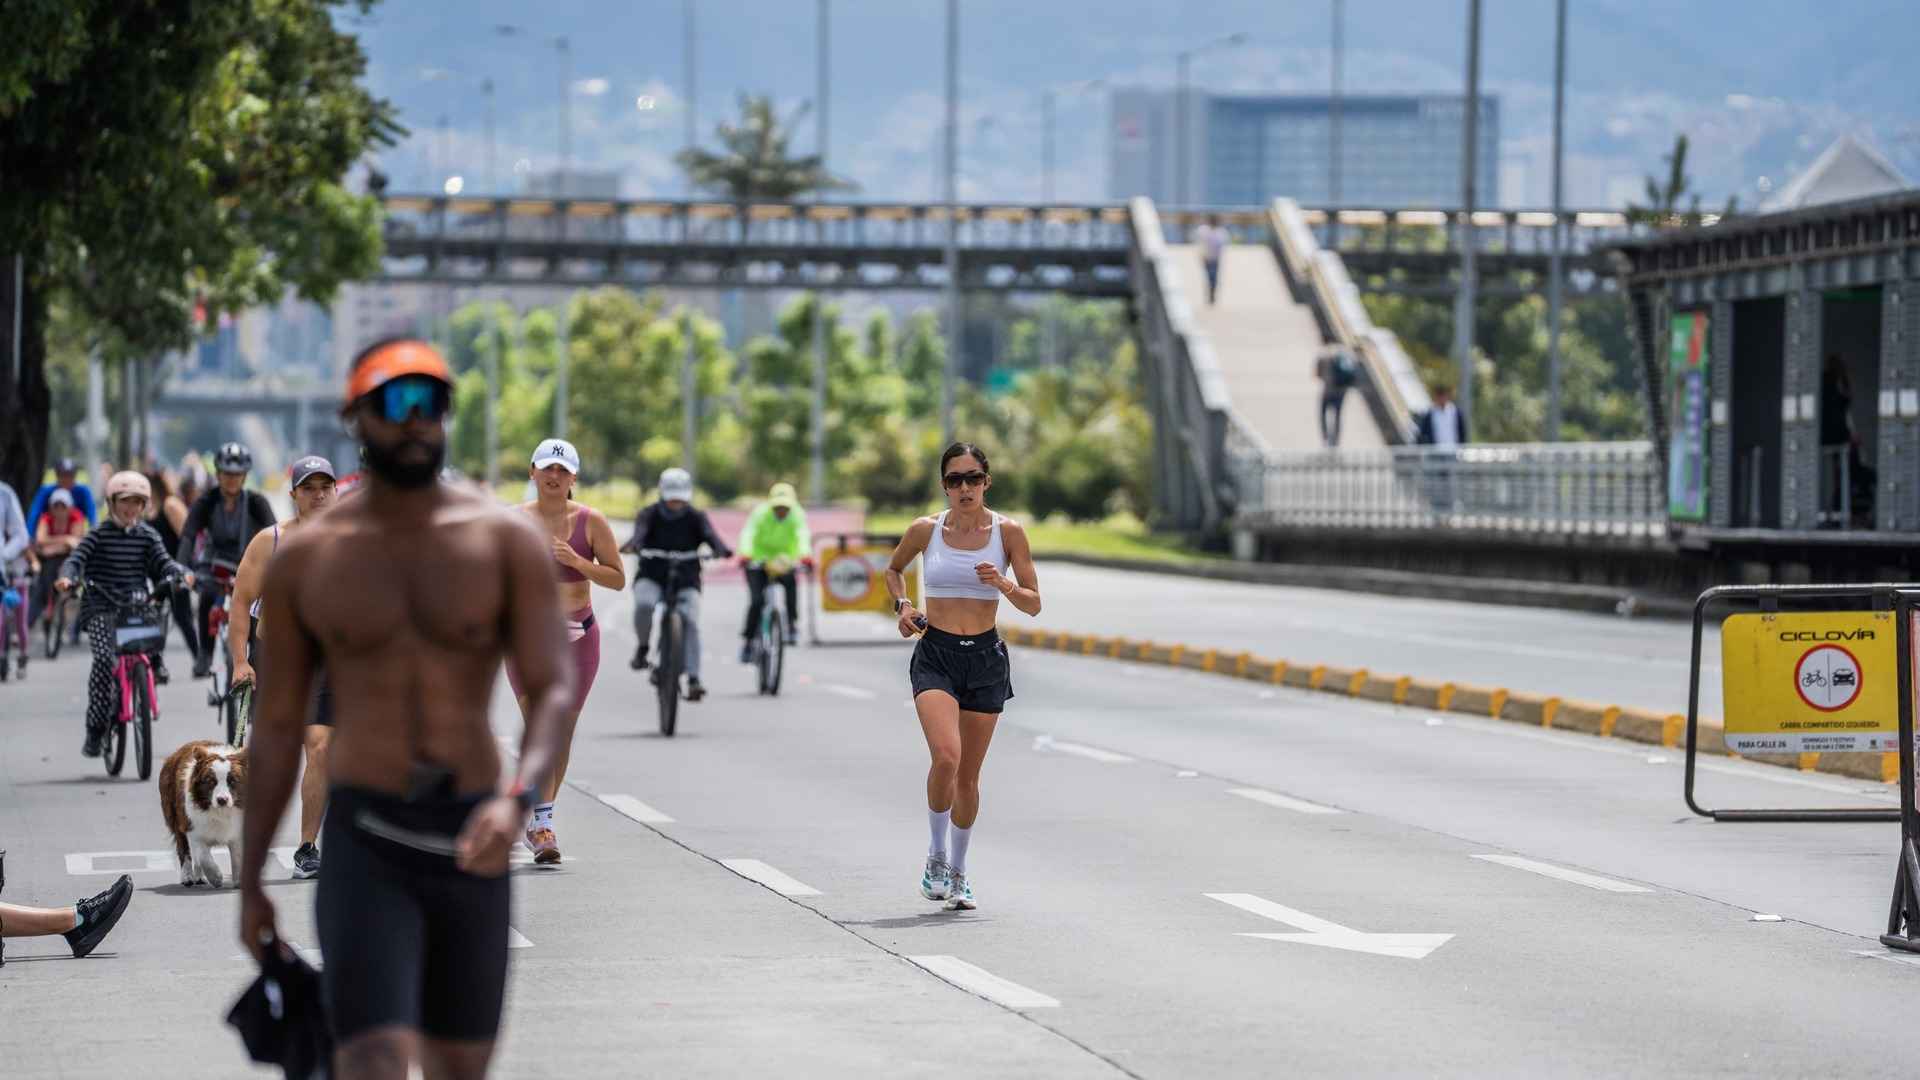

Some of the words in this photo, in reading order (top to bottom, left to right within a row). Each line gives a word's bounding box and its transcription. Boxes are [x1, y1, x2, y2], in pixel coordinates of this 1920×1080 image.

[552, 444, 565, 456] NY
[1779, 628, 1875, 641] CICLOVÍA
[1803, 721, 1845, 729] COMPARTIDO
[1738, 741, 1755, 749] PARA
[1757, 740, 1776, 748] CALLE
